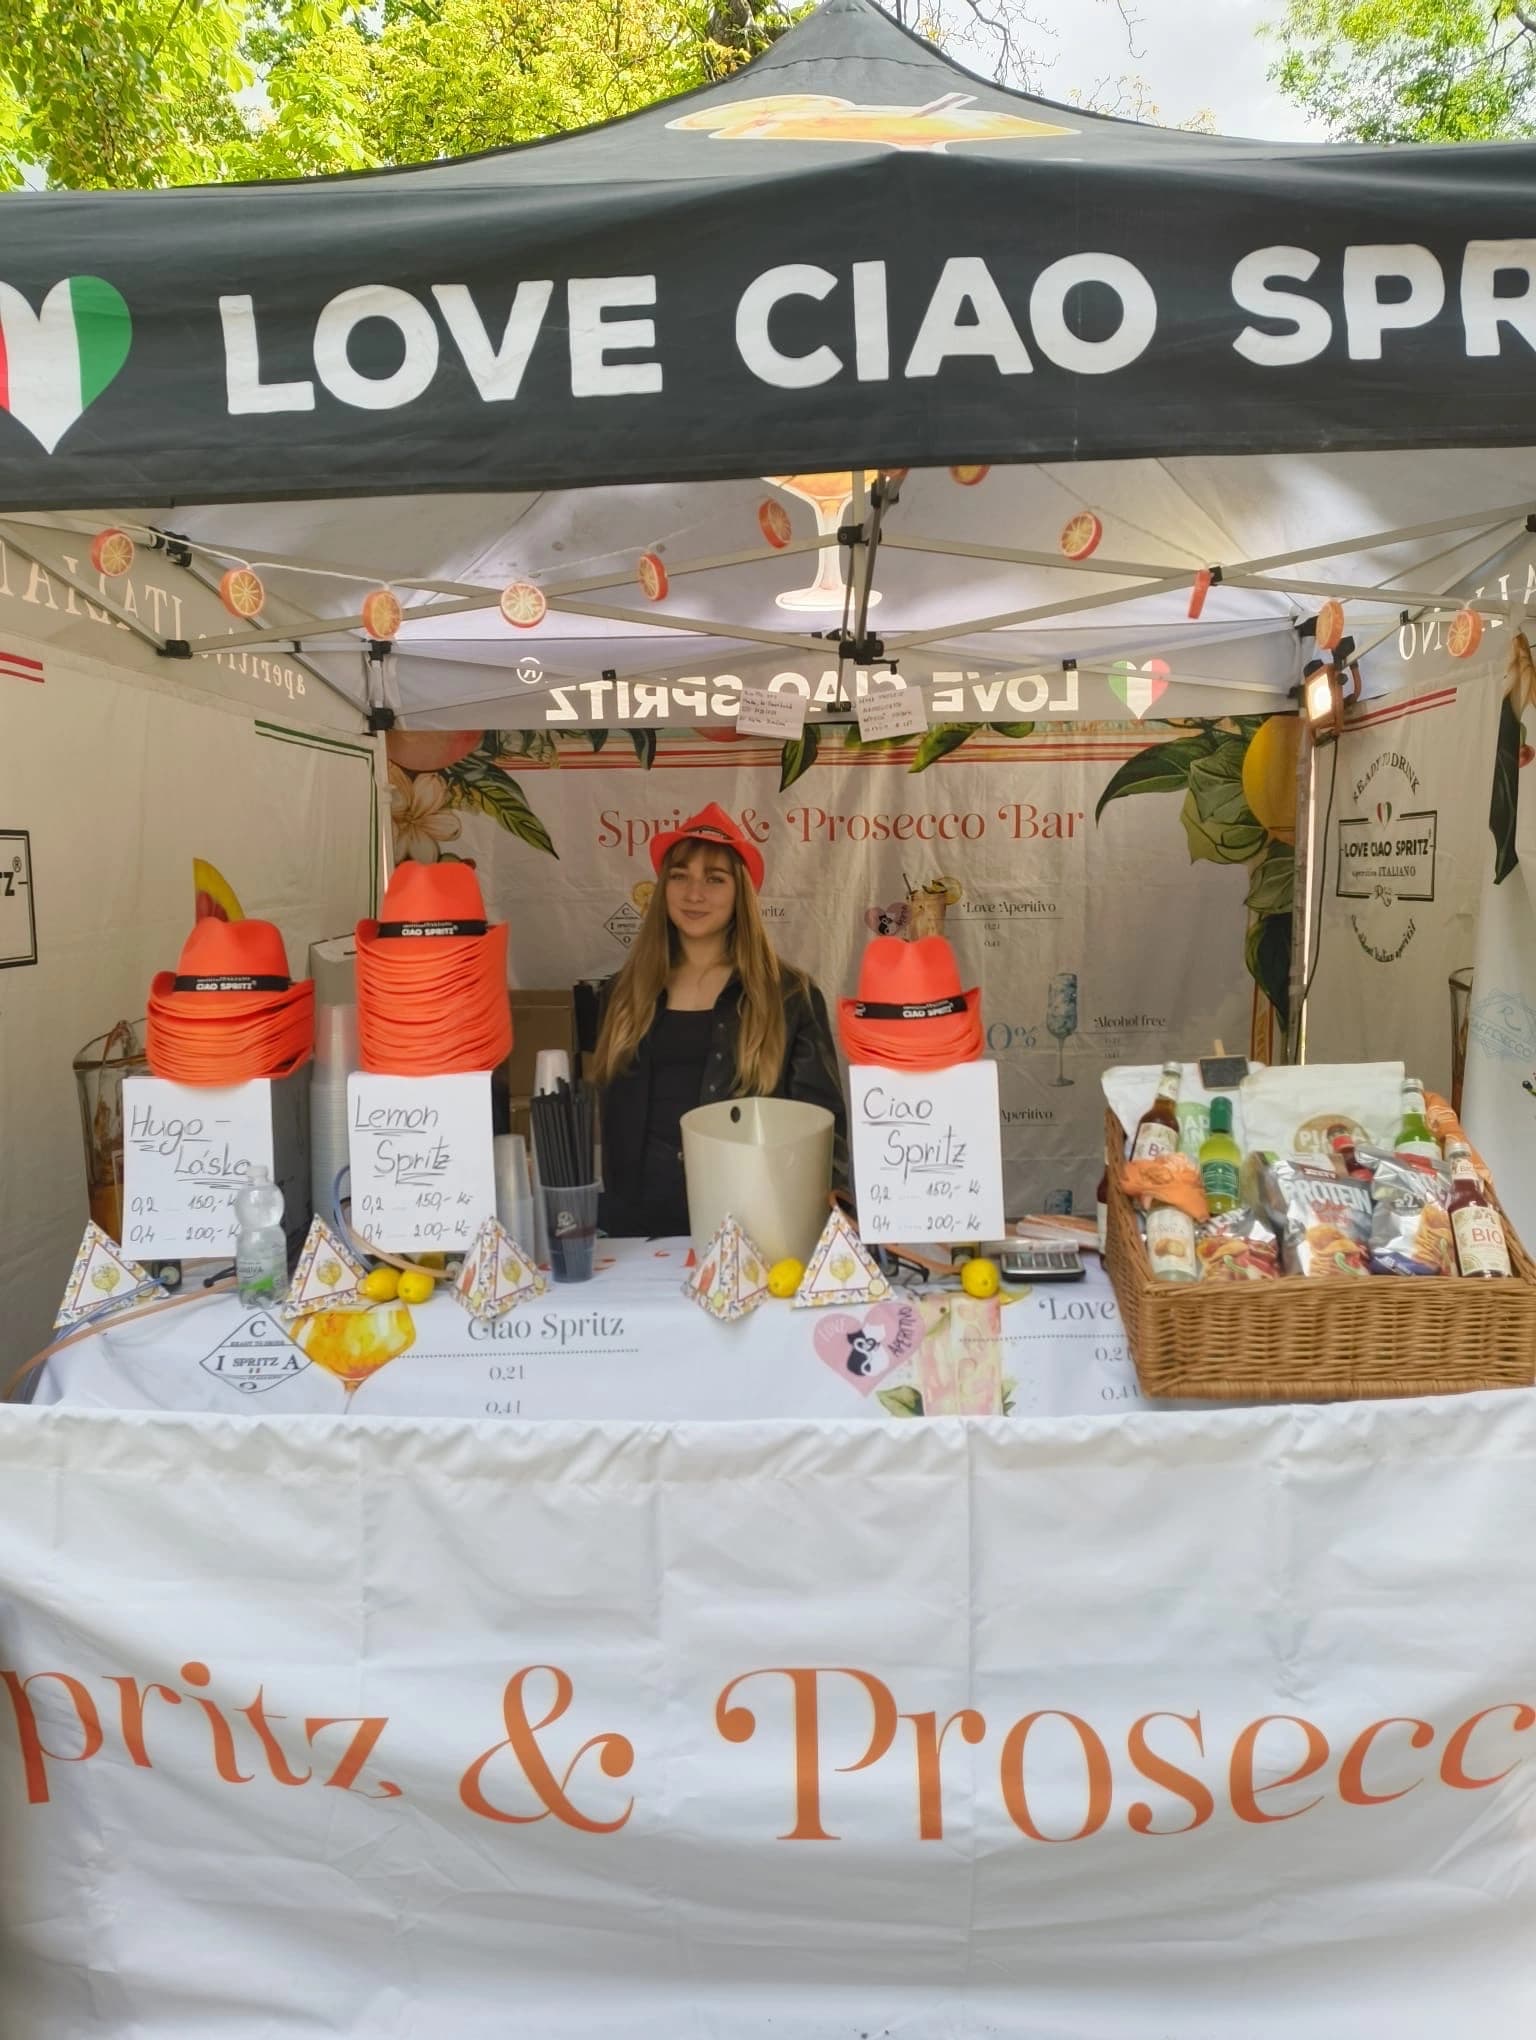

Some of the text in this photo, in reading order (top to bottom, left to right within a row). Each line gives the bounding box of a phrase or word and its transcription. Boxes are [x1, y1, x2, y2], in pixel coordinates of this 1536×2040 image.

[219, 239, 1536, 414] LOVE CIAO SPR
[598, 804, 682, 856] Spri
[786, 807, 985, 842] Prosecco
[998, 803, 1084, 840] Bar
[1344, 839, 1429, 857] LOVE CIAO SPRITZ
[963, 900, 1057, 917] Love Aperitivo
[1094, 1015, 1138, 1028] Alcohol
[355, 1095, 439, 1128] Lemon
[863, 1087, 933, 1120] Ciao
[1000, 1108, 1053, 1122] Aperitivo
[130, 1105, 204, 1156] Hugo
[374, 1136, 451, 1185] Spritz
[883, 1125, 967, 1184] Spritz
[361, 1195, 384, 1215] 0,2
[870, 1184, 892, 1204] 0,2
[1279, 1178, 1373, 1216] PROTEIN
[131, 1196, 159, 1216] 0,2
[130, 1224, 154, 1244] 0,4
[872, 1214, 891, 1232] 0,4
[1038, 1297, 1116, 1321] Love
[249, 1320, 267, 1338] C
[468, 1312, 625, 1345] Ciao Spritz
[232, 1357, 280, 1367] SPRITZ
[282, 1354, 300, 1370] A
[0, 1661, 1536, 1843] pritz & Prosecc
